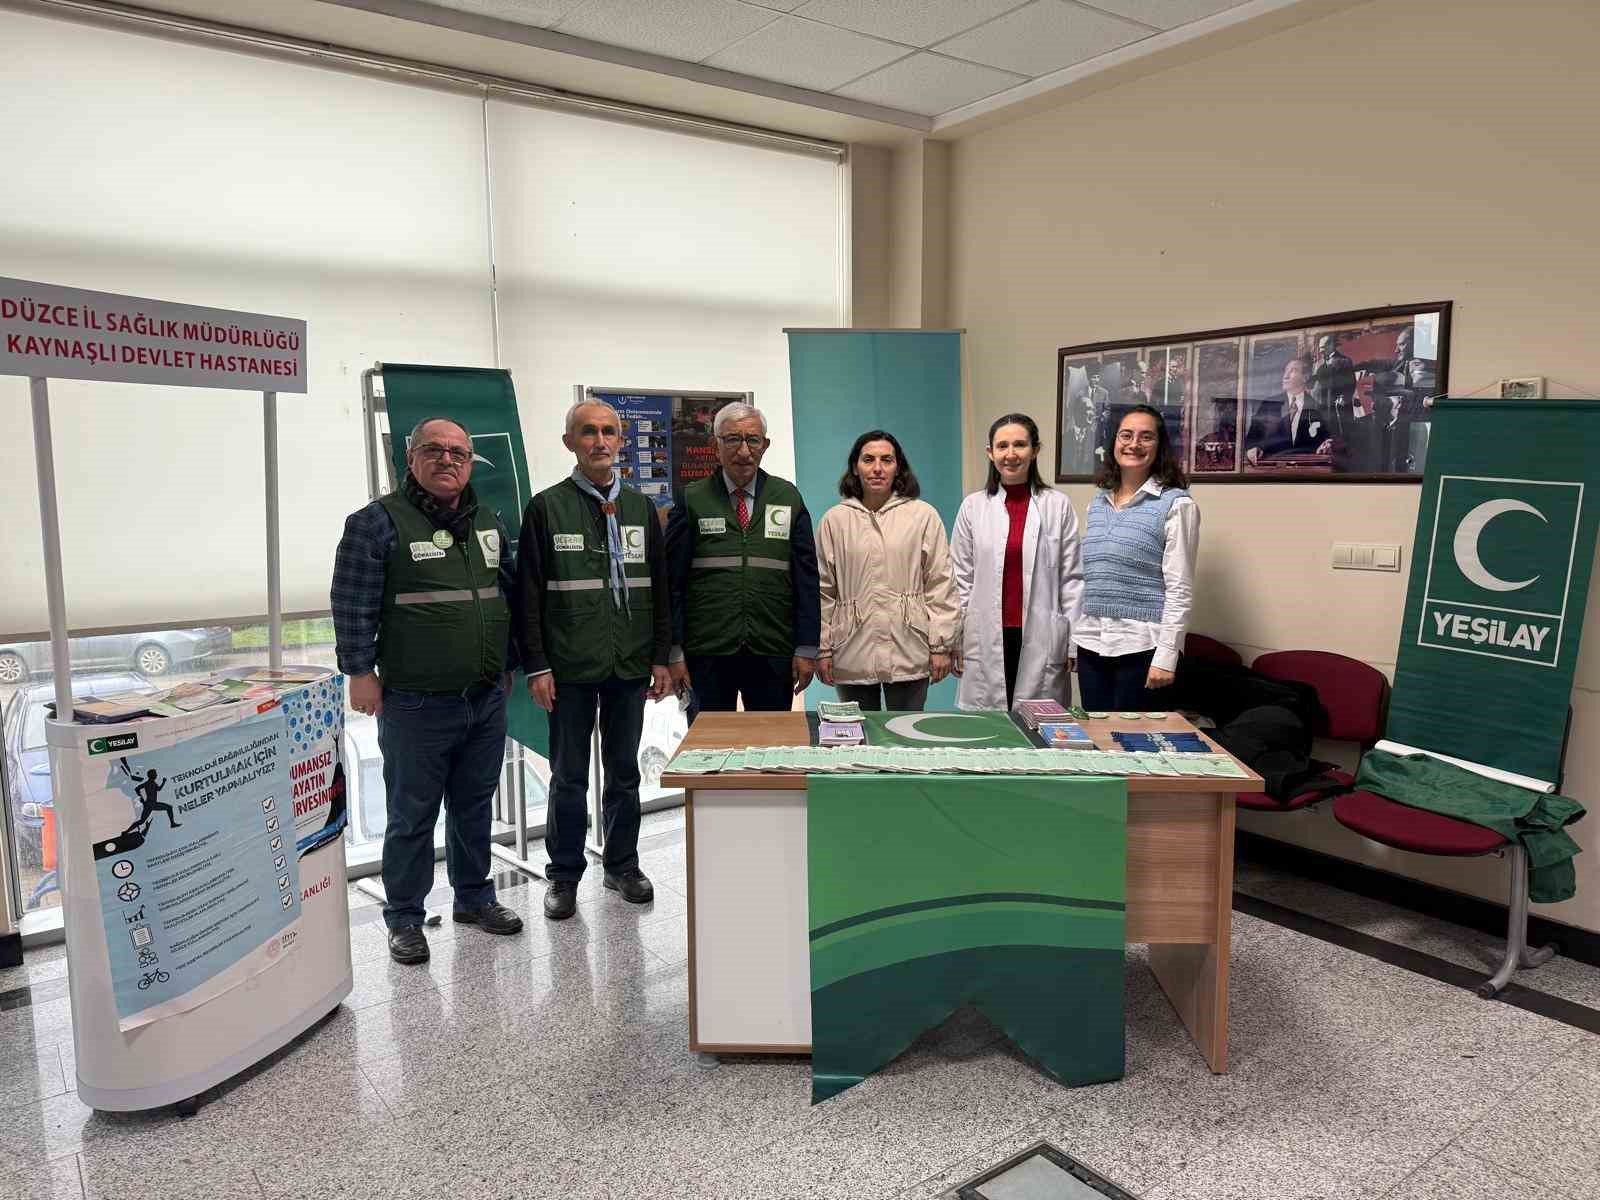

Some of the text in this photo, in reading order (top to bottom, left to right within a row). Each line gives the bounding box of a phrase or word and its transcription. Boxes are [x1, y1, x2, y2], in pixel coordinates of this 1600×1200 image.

[1, 298, 299, 351] DÜZCE İL SAĞLIK MÜDÜRLÜĞÜ
[7, 333, 297, 376] KAYNAŞLI DEVLET HASTANESİ
[174, 745, 277, 800] KURTULMAK İÇİN
[177, 762, 276, 814] NELER YAPMALIYIZ?
[290, 750, 332, 780] UMANSIZ
[292, 771, 326, 800] AYATIN
